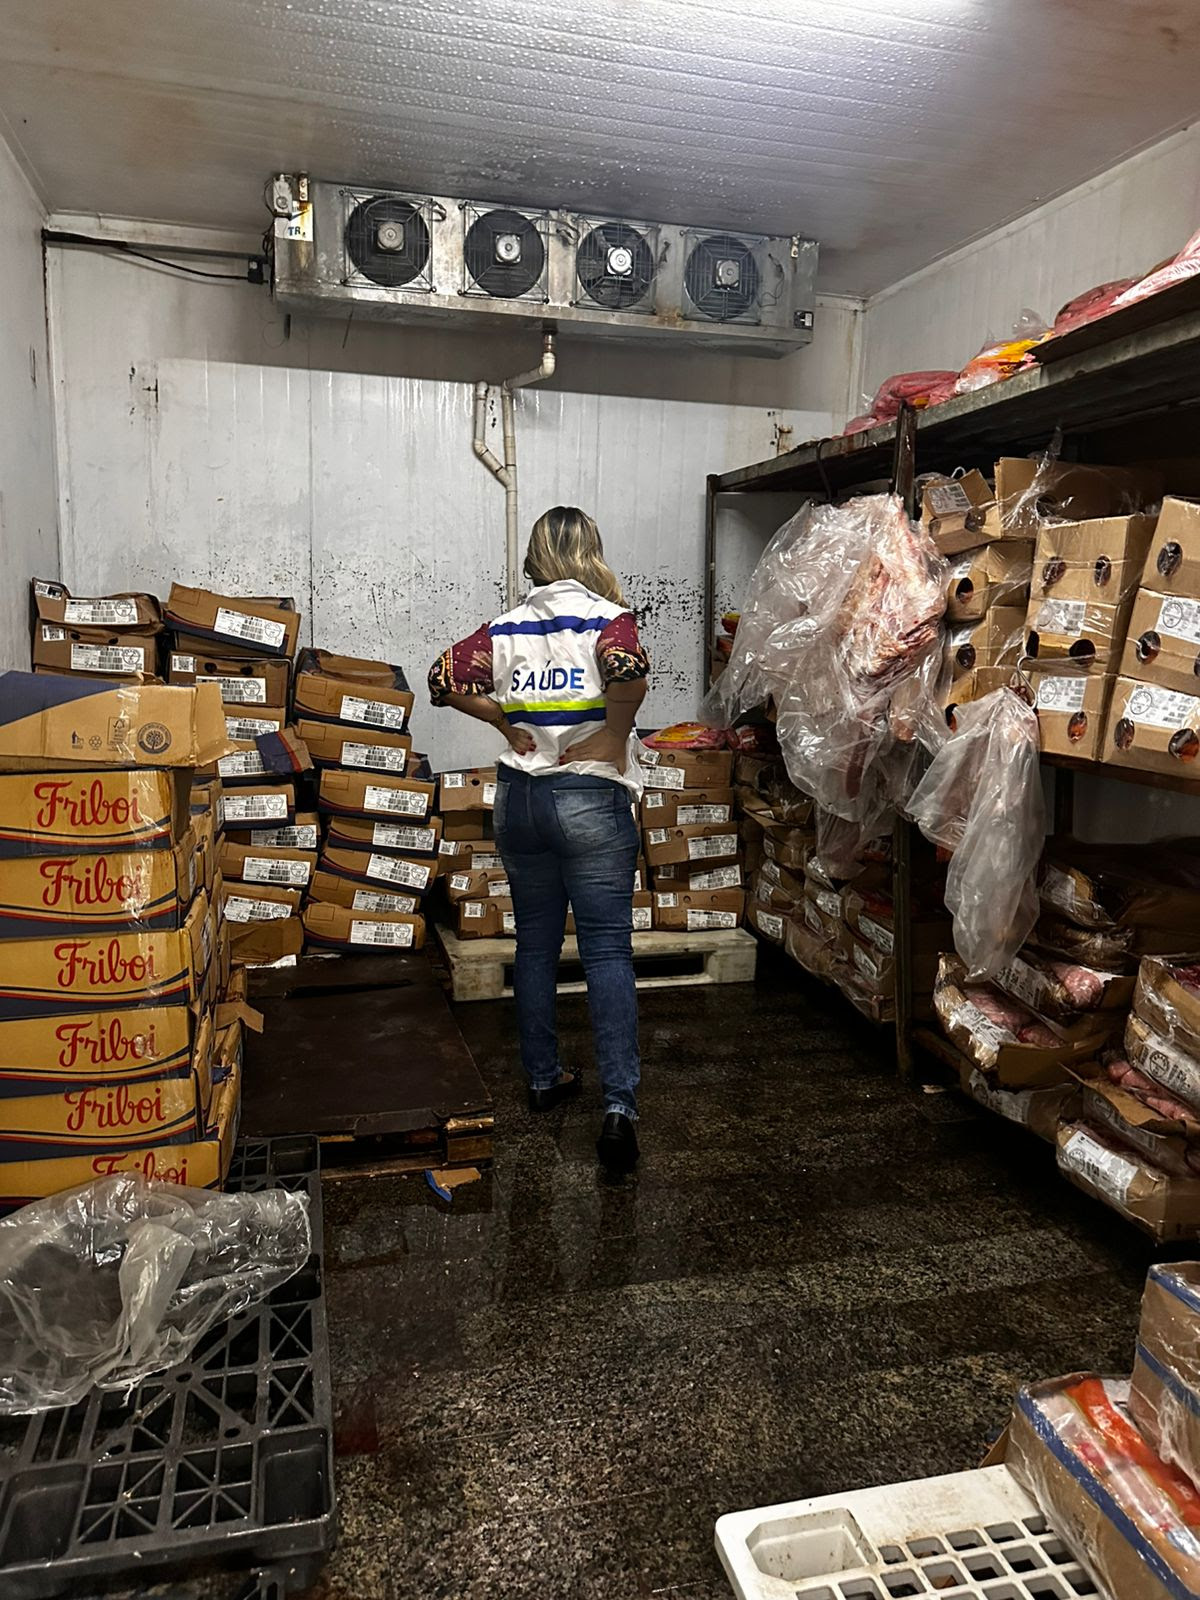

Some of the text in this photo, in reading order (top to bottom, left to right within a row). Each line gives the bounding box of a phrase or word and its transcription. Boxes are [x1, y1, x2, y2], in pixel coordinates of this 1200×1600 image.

[511, 660, 585, 692] SAÚDE
[34, 779, 144, 828] Friboi
[40, 856, 142, 906] Friboi
[54, 938, 161, 987] Friboi
[55, 1018, 161, 1067] Friboi
[64, 1084, 166, 1131] Friboi
